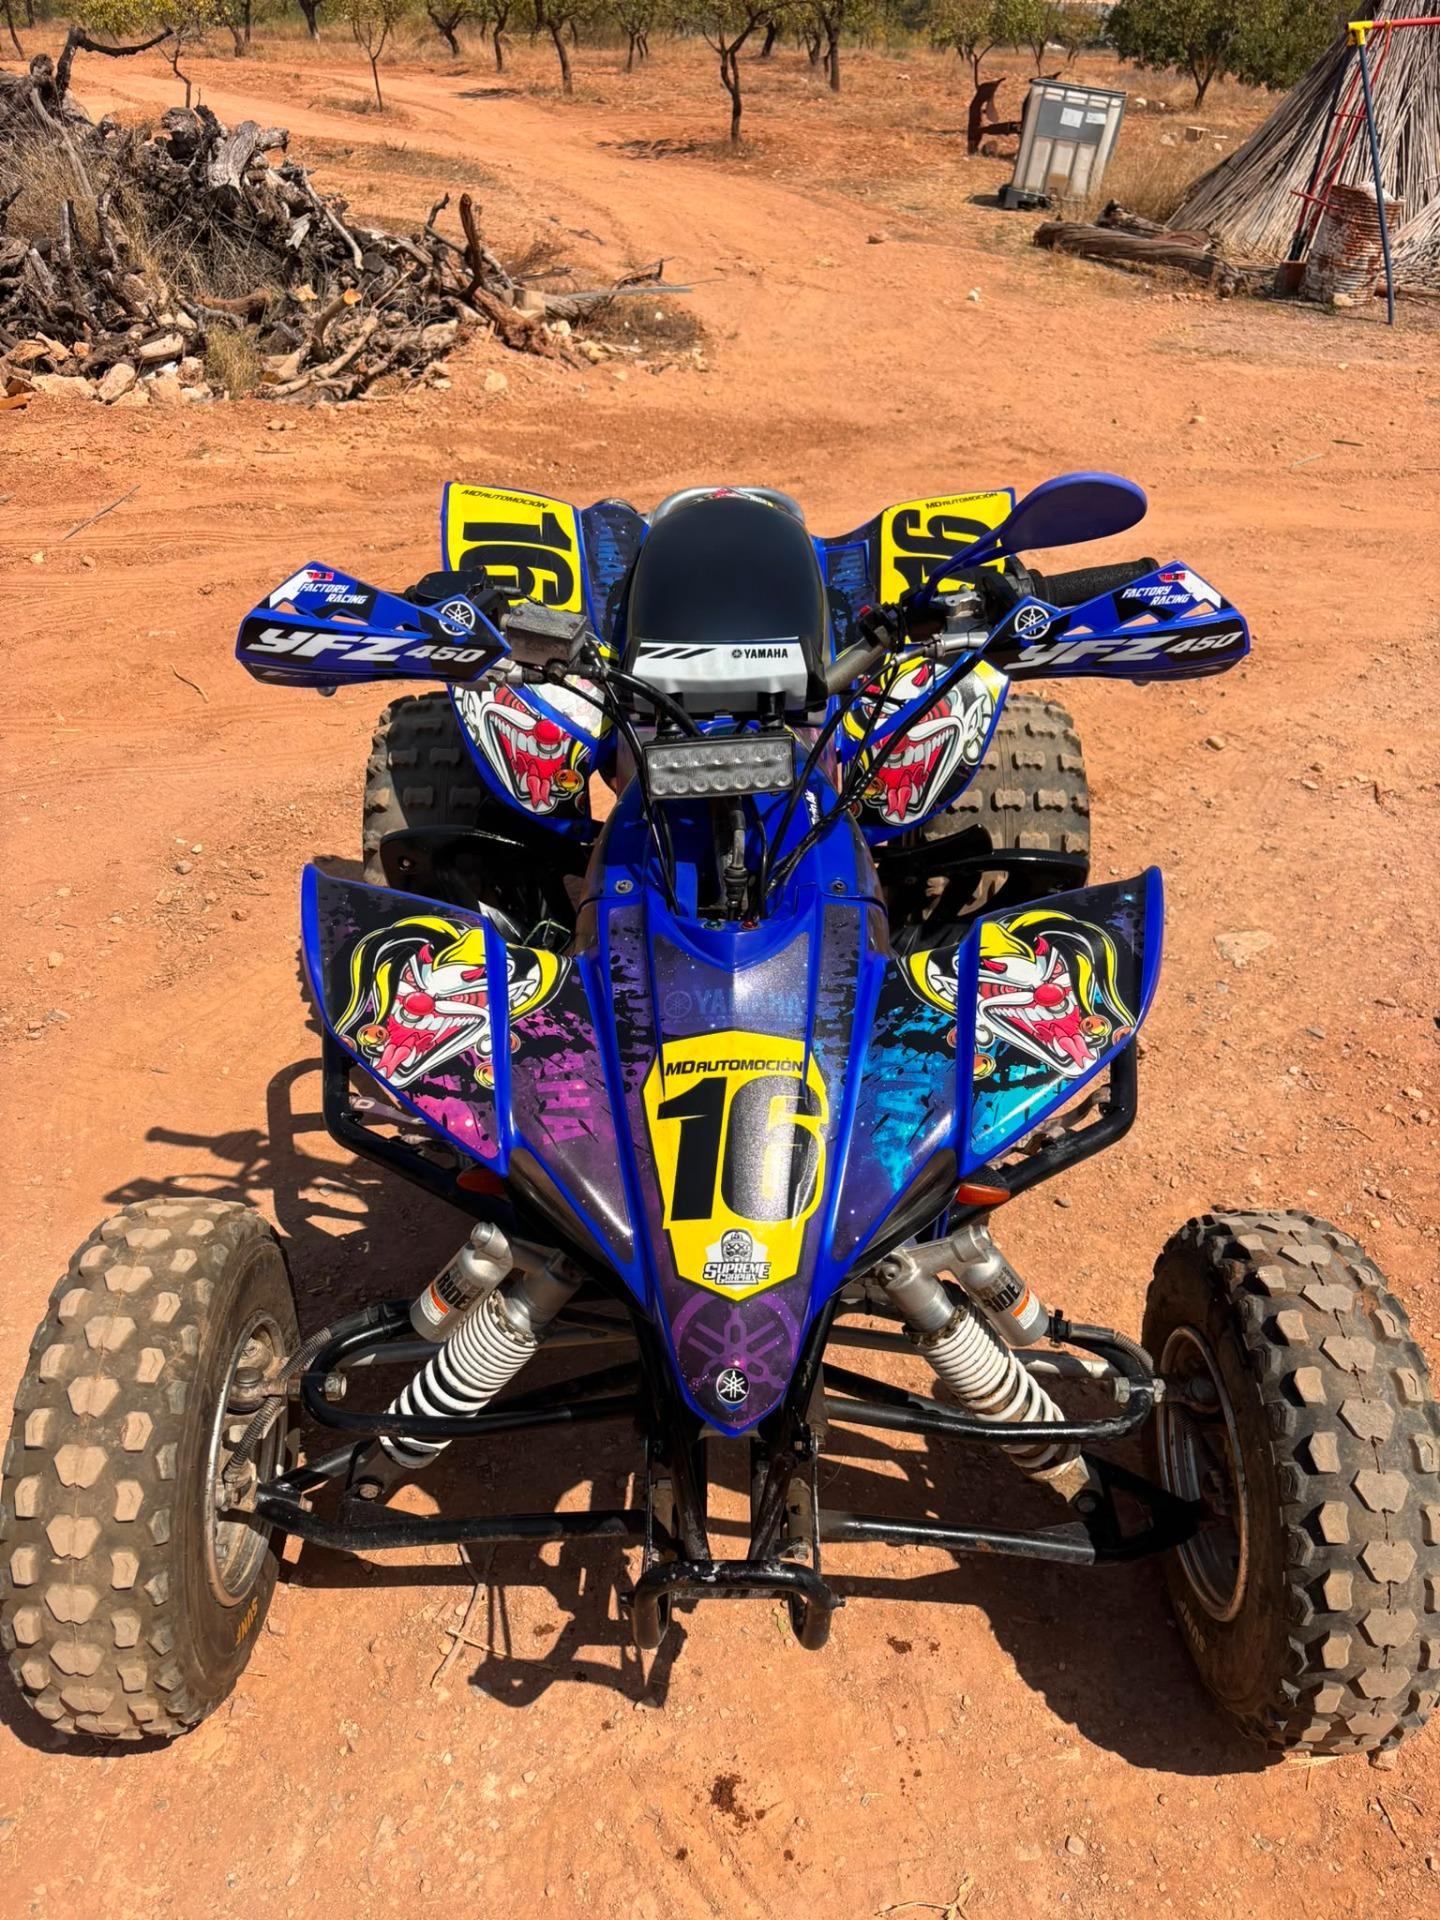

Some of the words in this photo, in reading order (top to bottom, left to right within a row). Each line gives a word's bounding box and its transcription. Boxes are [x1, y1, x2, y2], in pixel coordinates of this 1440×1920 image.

[458, 511, 575, 607] 16
[299, 582, 350, 595] FACTORY
[1121, 585, 1173, 599] FACTORY
[325, 592, 369, 605] RACING
[1150, 593, 1191, 606] RACING
[744, 648, 788, 659] YAMAHA
[656, 1074, 824, 1222] 16
[703, 1262, 772, 1281] SUPREME
[715, 1273, 759, 1285] GRAPHIX
